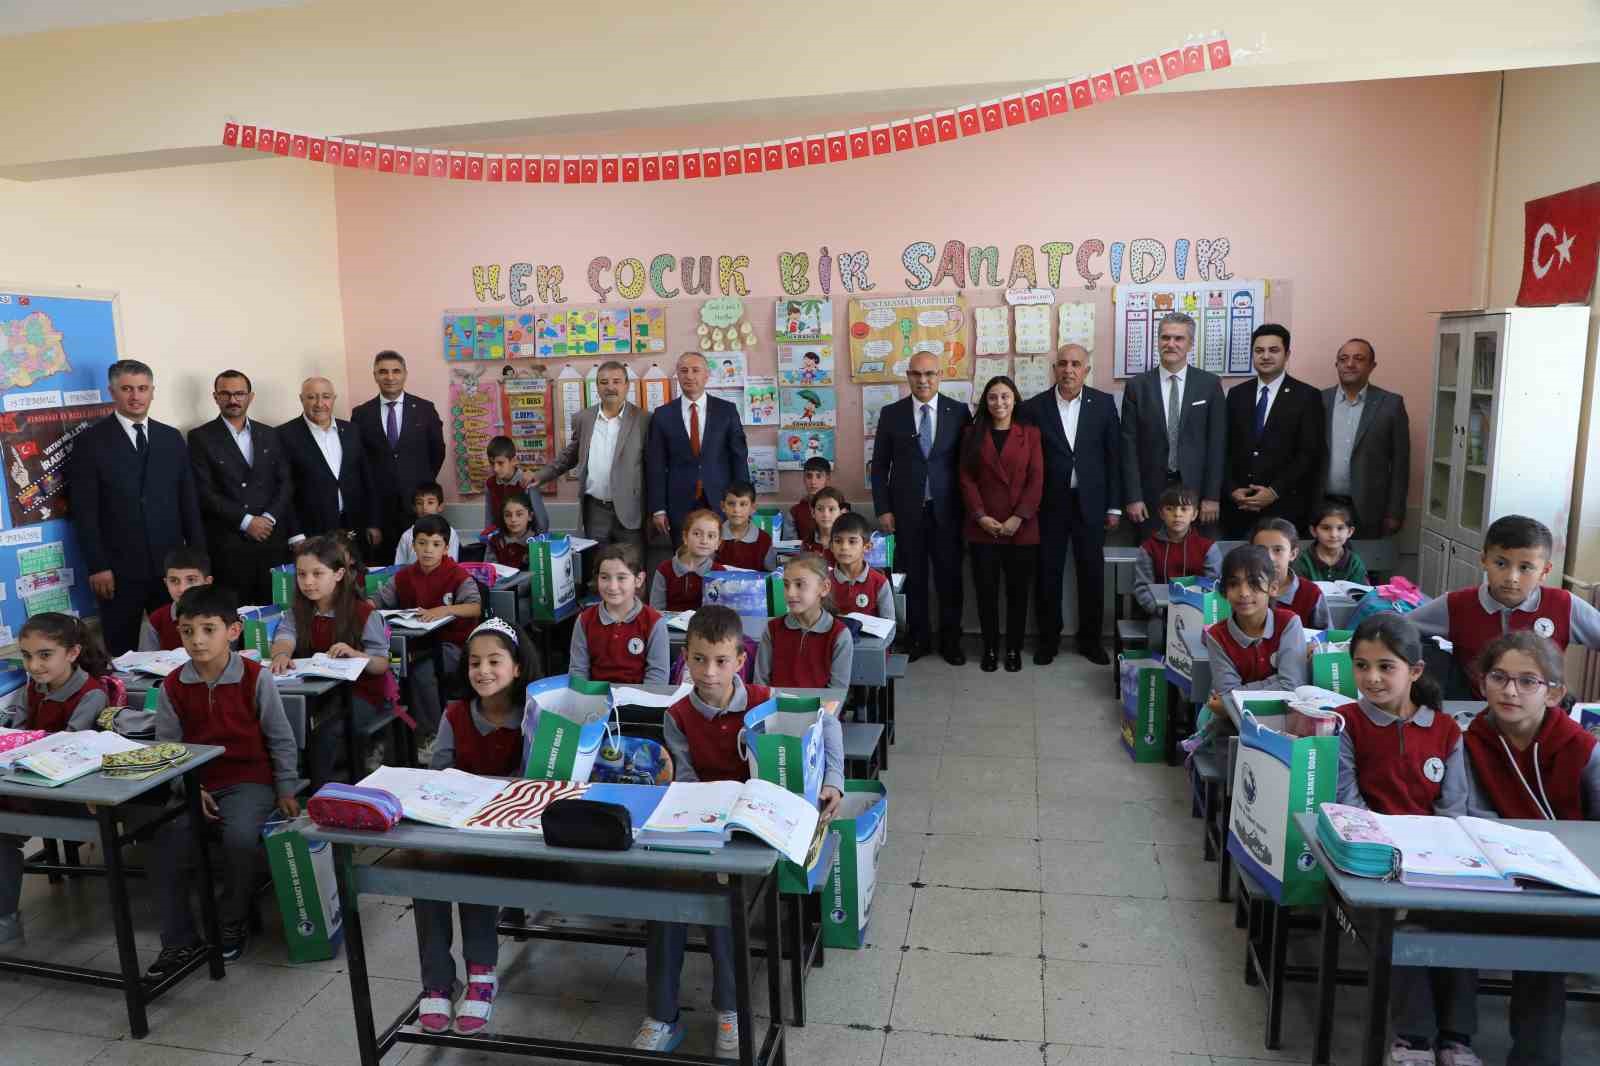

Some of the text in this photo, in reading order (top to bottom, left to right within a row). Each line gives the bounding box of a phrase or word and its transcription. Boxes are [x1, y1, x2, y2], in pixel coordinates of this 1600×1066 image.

[472, 237, 1235, 307] HER ÇOCUK BİR SANATÇIDIR
[552, 727, 565, 747] ODASI
[547, 747, 560, 770] SANAYİ
[1307, 748, 1317, 770] ODASI
[1305, 770, 1316, 795] SANAYİ
[1306, 797, 1314, 805] VE
